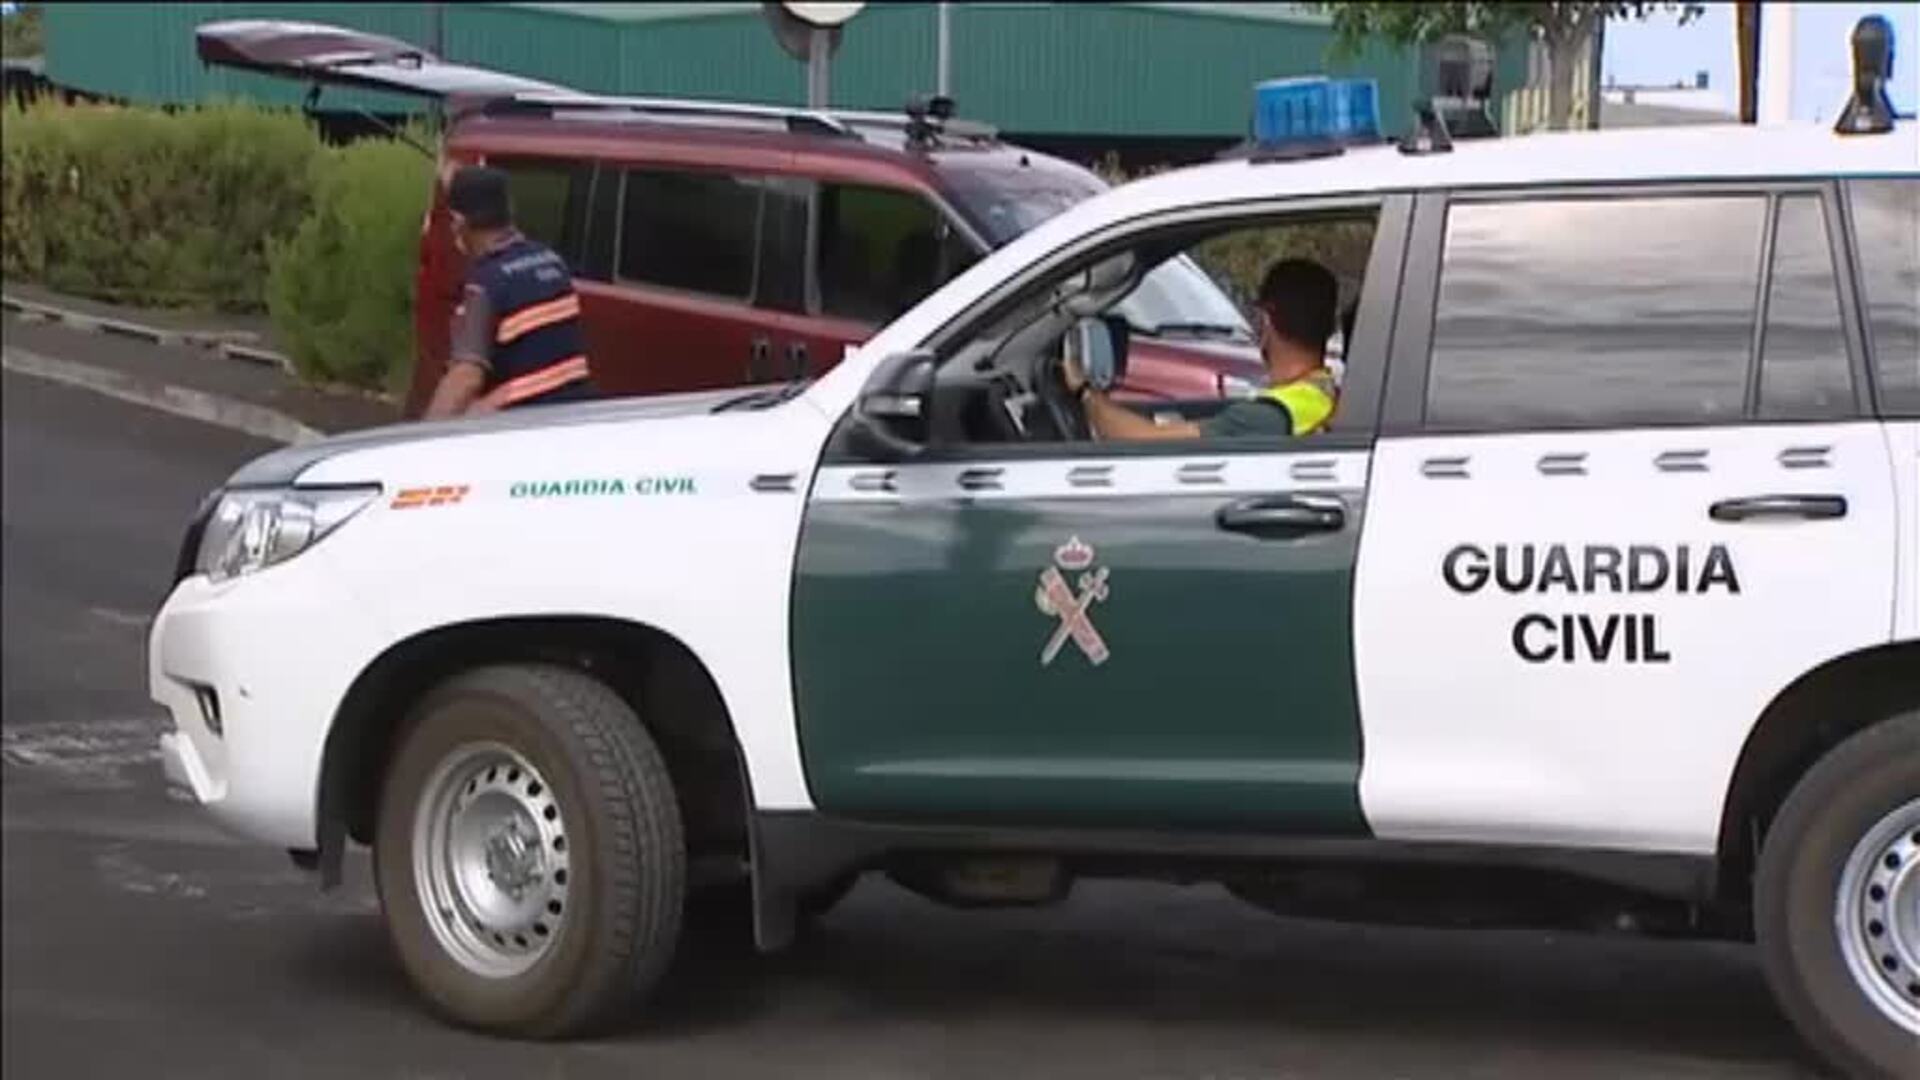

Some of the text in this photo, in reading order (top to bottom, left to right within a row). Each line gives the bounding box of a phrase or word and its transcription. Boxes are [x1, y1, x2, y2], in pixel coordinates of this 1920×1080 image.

[509, 476, 698, 498] GUARDIA CIVIL
[1442, 543, 1741, 595] GUARDIA
[1511, 612, 1671, 663] CIVIL
